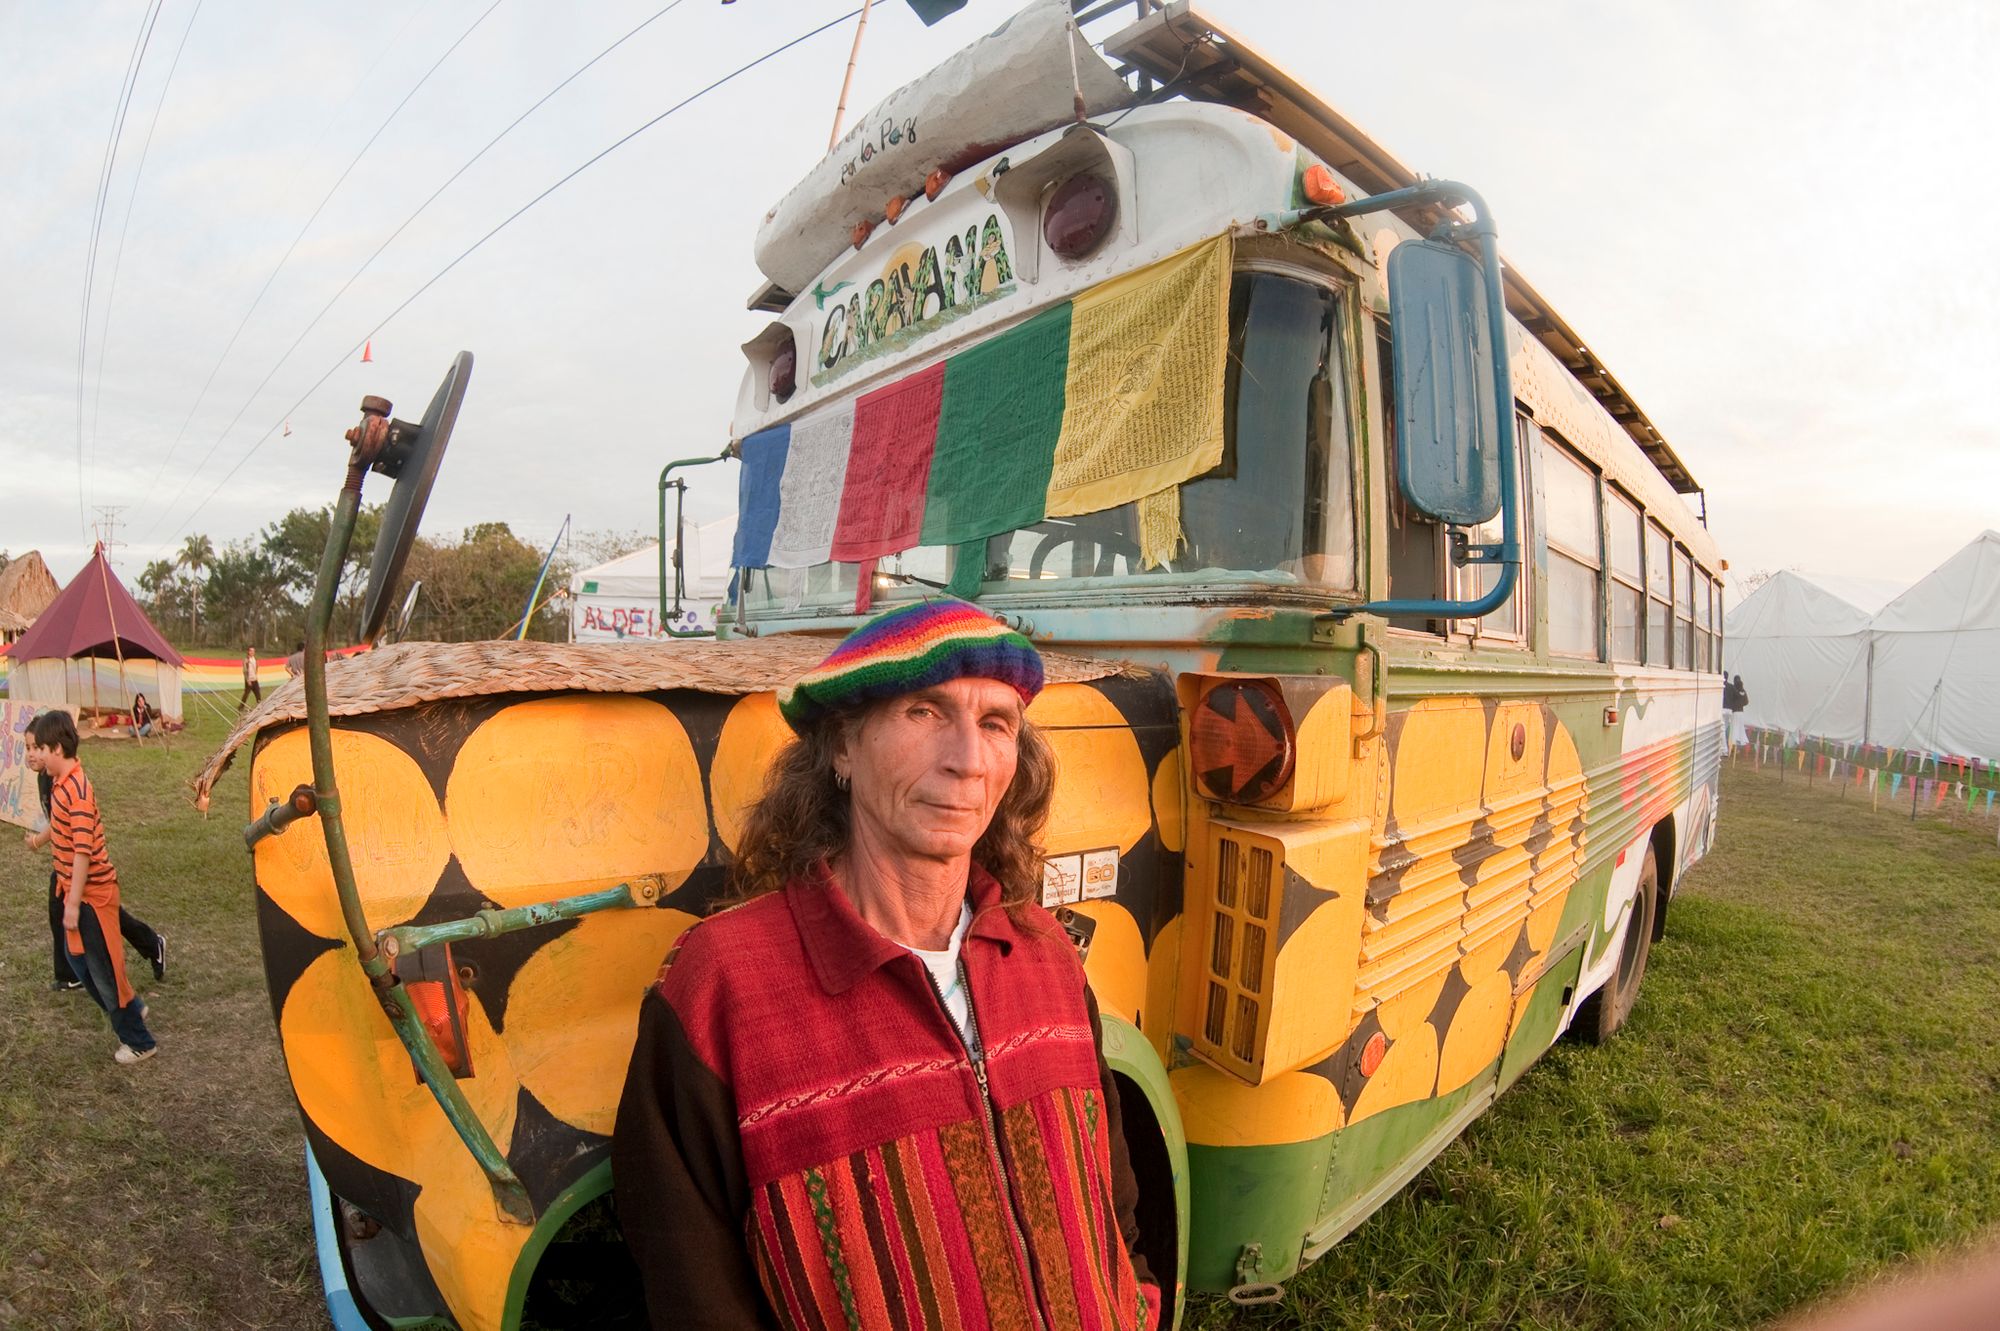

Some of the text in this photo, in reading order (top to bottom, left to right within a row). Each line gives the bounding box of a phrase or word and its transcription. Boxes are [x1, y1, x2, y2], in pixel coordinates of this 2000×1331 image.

[860, 139, 877, 163] la
[881, 115, 918, 151] Paz
[821, 214, 1013, 369] CARAVANA
